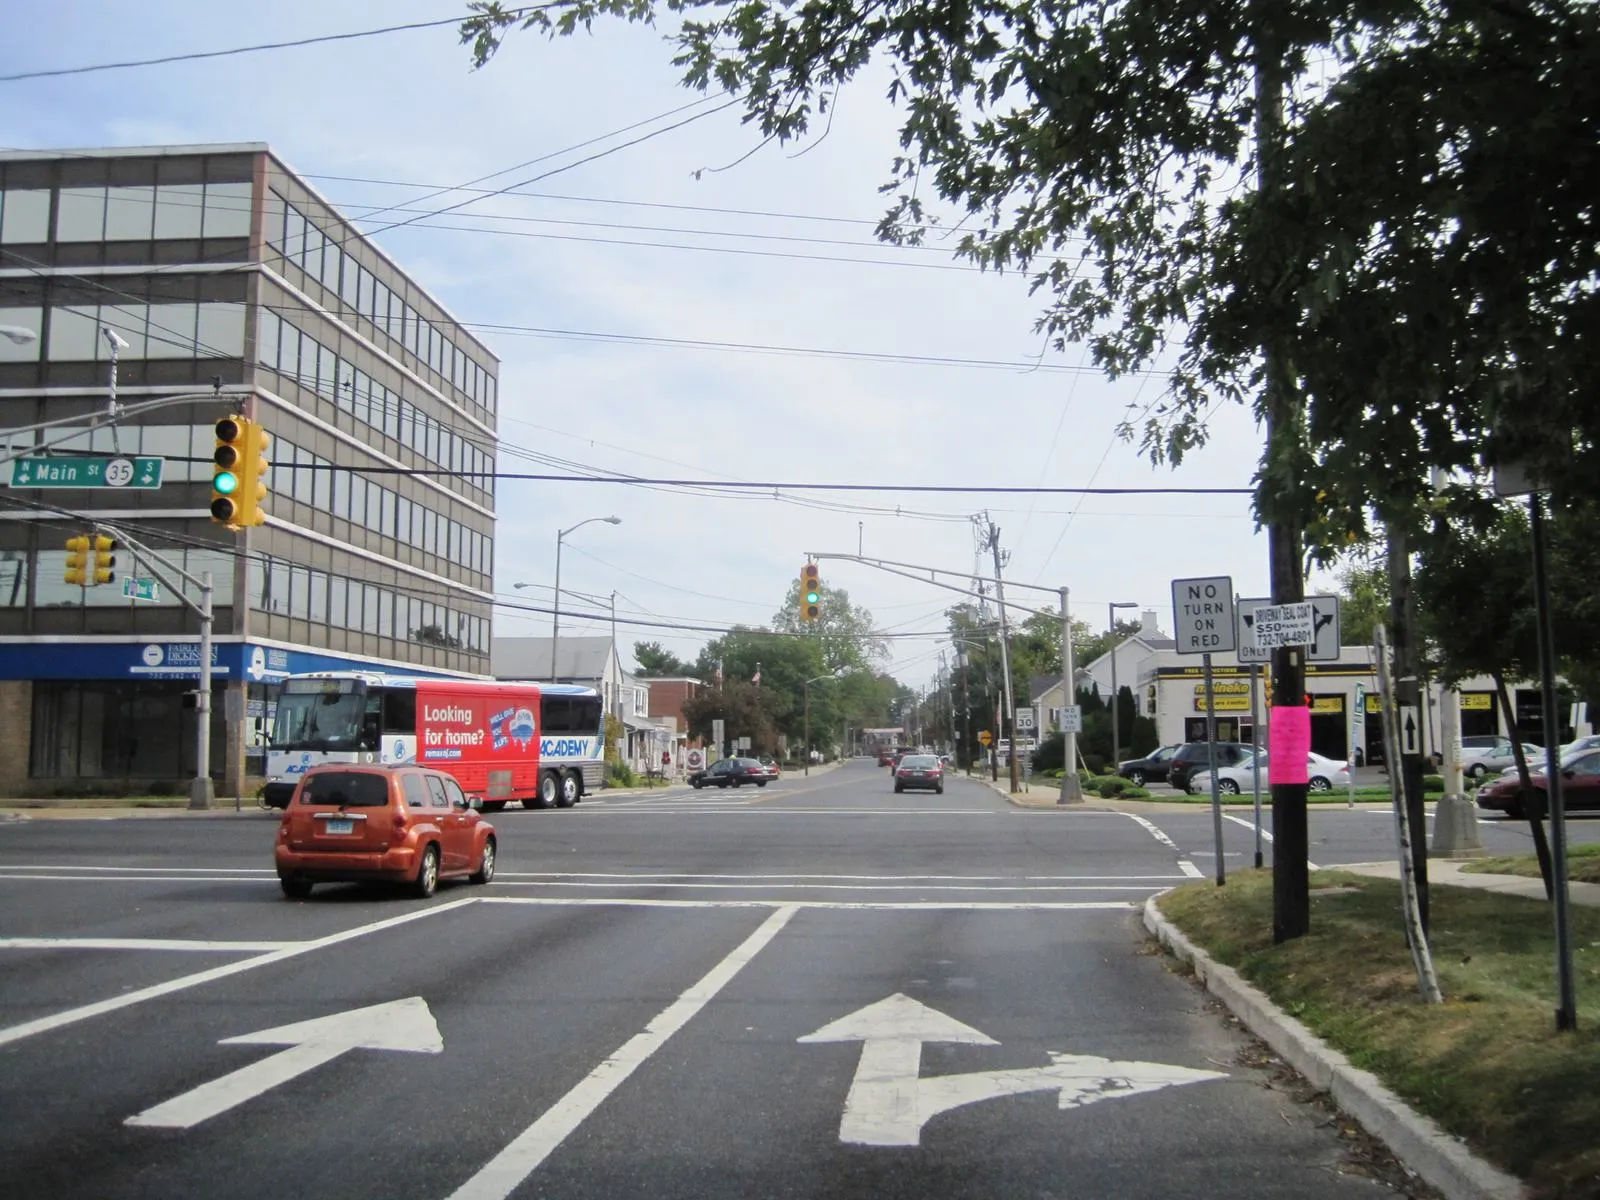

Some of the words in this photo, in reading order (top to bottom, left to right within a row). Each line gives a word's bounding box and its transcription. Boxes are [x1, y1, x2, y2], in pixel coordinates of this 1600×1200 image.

[22, 461, 30, 471] N
[36, 464, 77, 481] Main
[88, 464, 99, 476] St
[109, 464, 130, 481] 35
[146, 462, 153, 472] S
[1188, 584, 1217, 599] NO
[1183, 602, 1224, 616] TURN
[1255, 608, 1281, 623] DRIVEWAY
[1281, 605, 1296, 620] SEAL
[1296, 604, 1311, 619] COAT
[1194, 619, 1215, 631] ON
[1191, 634, 1220, 647] RED
[1257, 630, 1312, 646] 732-704-4801
[1242, 646, 1266, 657] ONLY
[424, 704, 472, 725] Looking
[1018, 719, 1033, 727] 30
[425, 727, 443, 745] for
[445, 728, 485, 745] home?
[540, 739, 589, 757] ACADEMY
